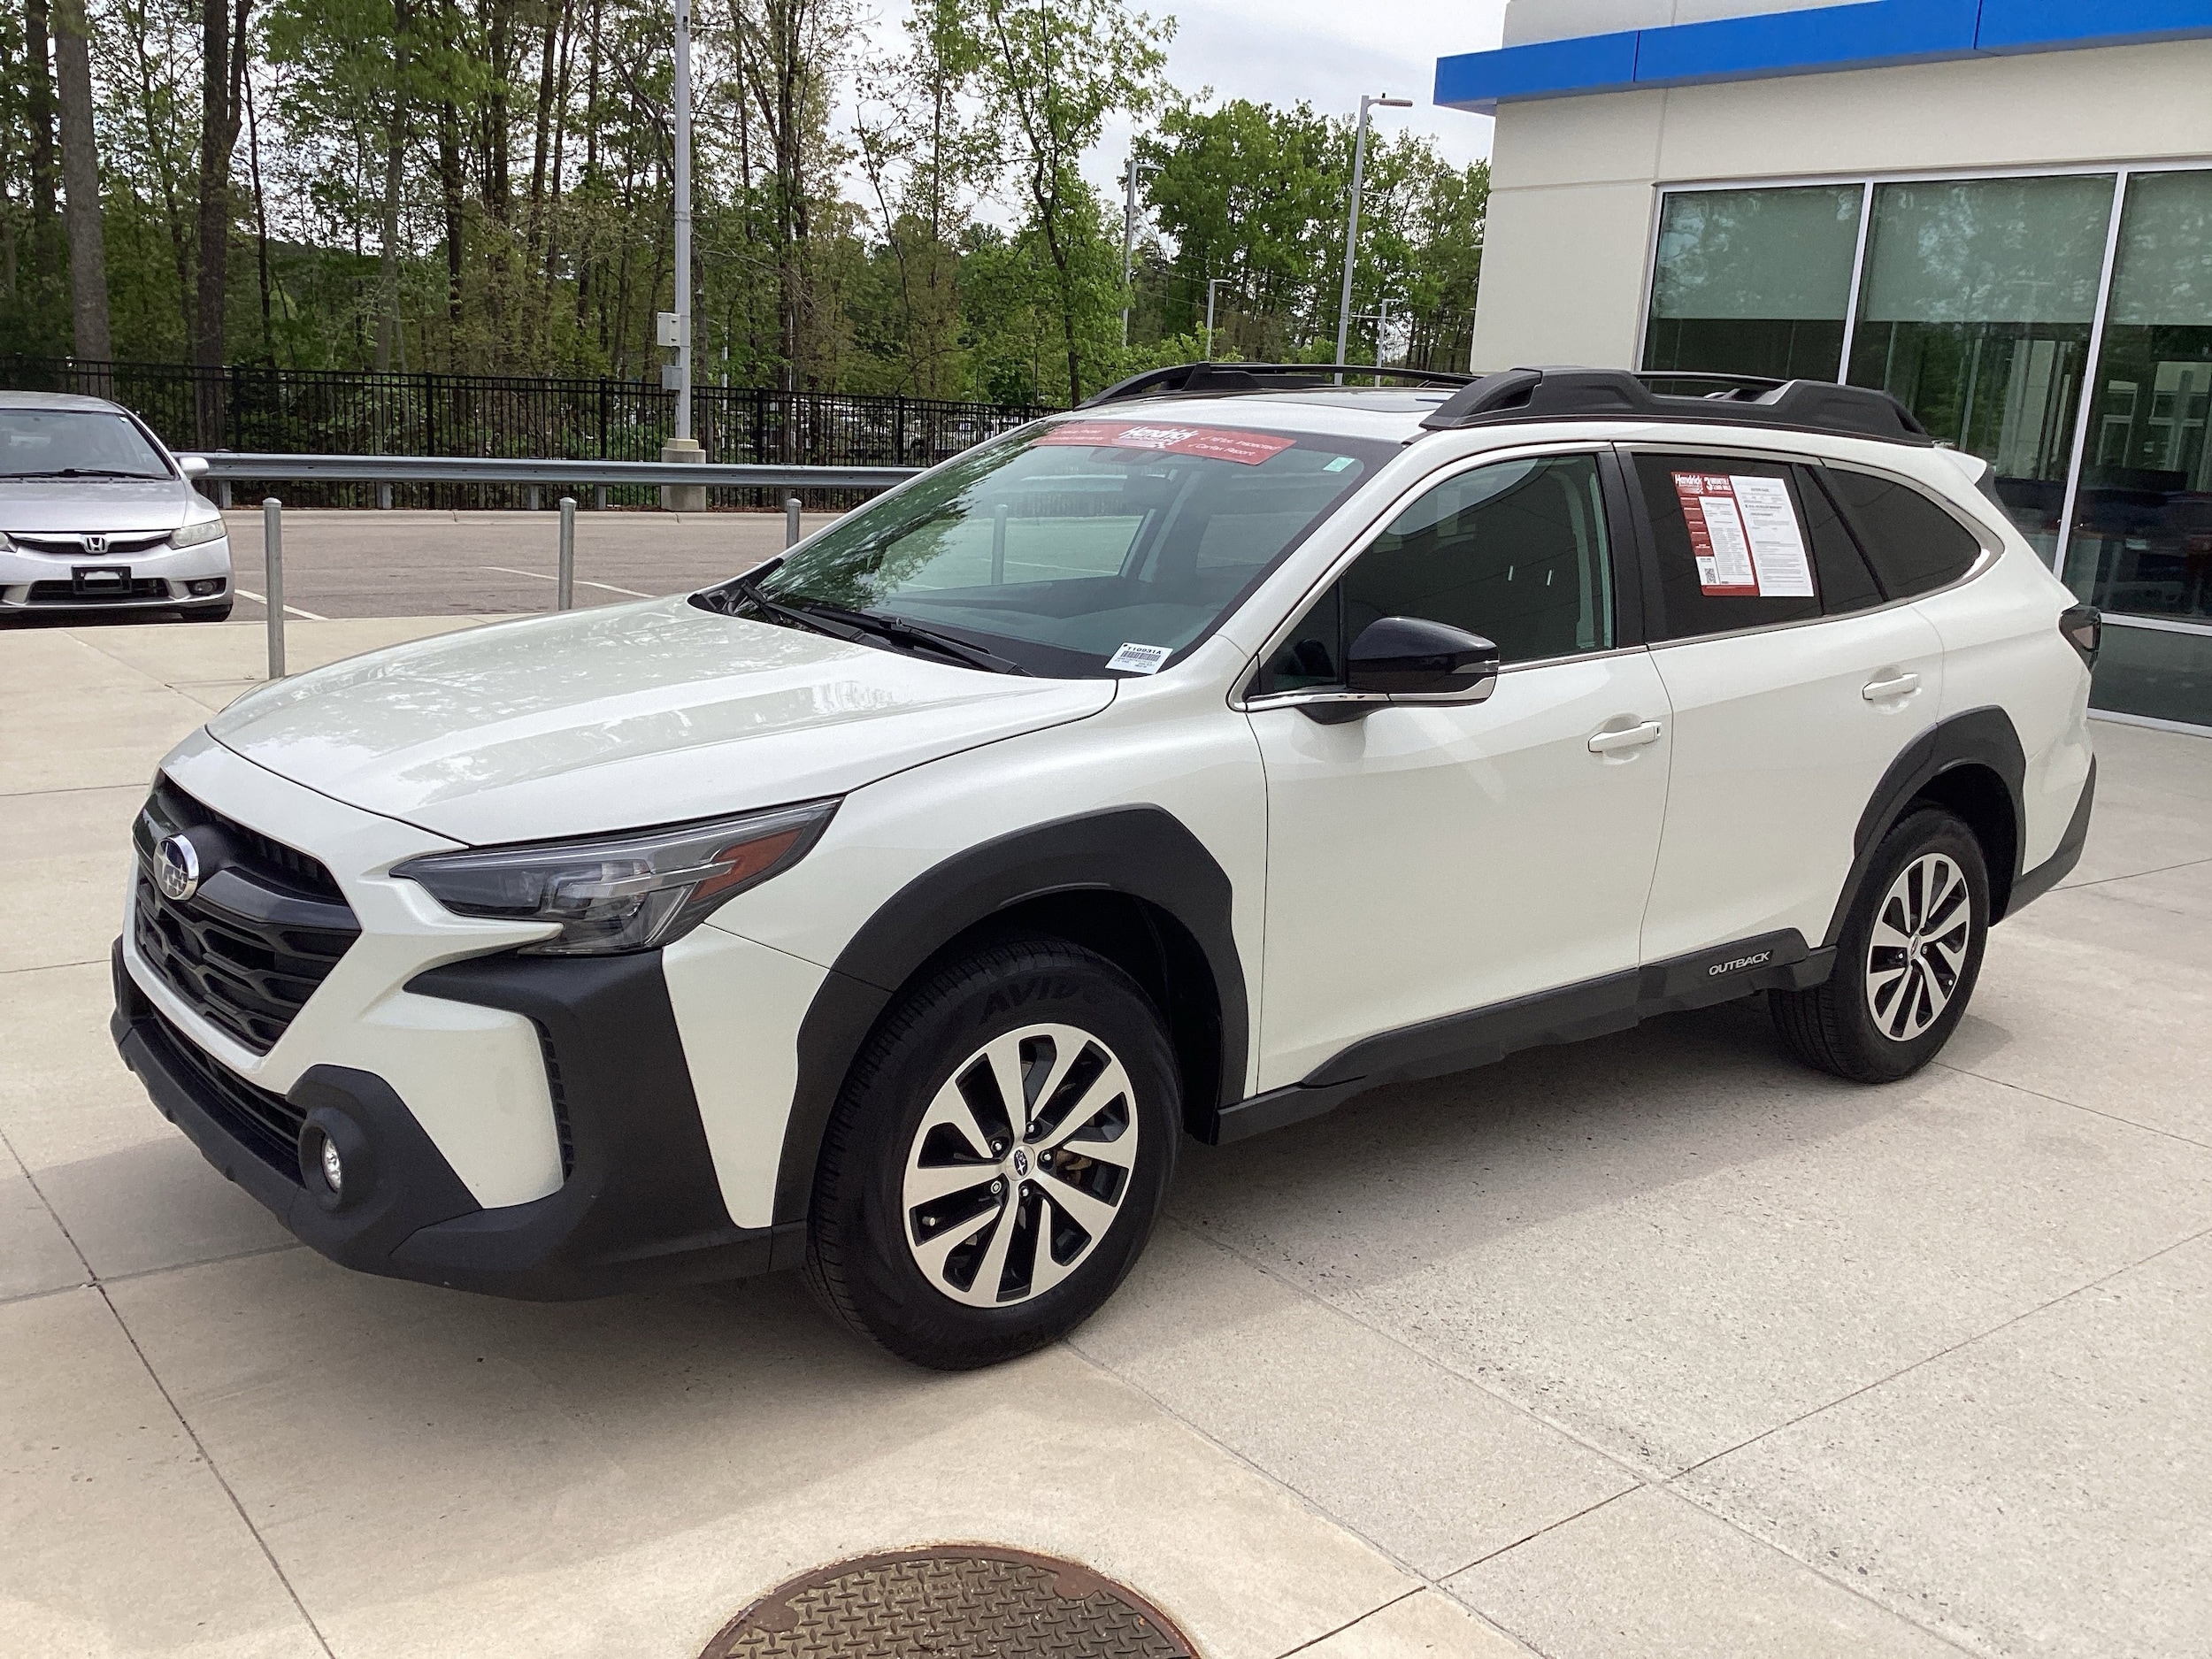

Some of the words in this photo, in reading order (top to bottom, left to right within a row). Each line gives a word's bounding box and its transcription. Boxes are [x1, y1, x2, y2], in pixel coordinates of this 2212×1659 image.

[1195, 443, 1225, 452] Carfax
[1225, 447, 1256, 457] Report
[1703, 476, 1713, 491] 3
[1708, 950, 1771, 976] OUTBACK
